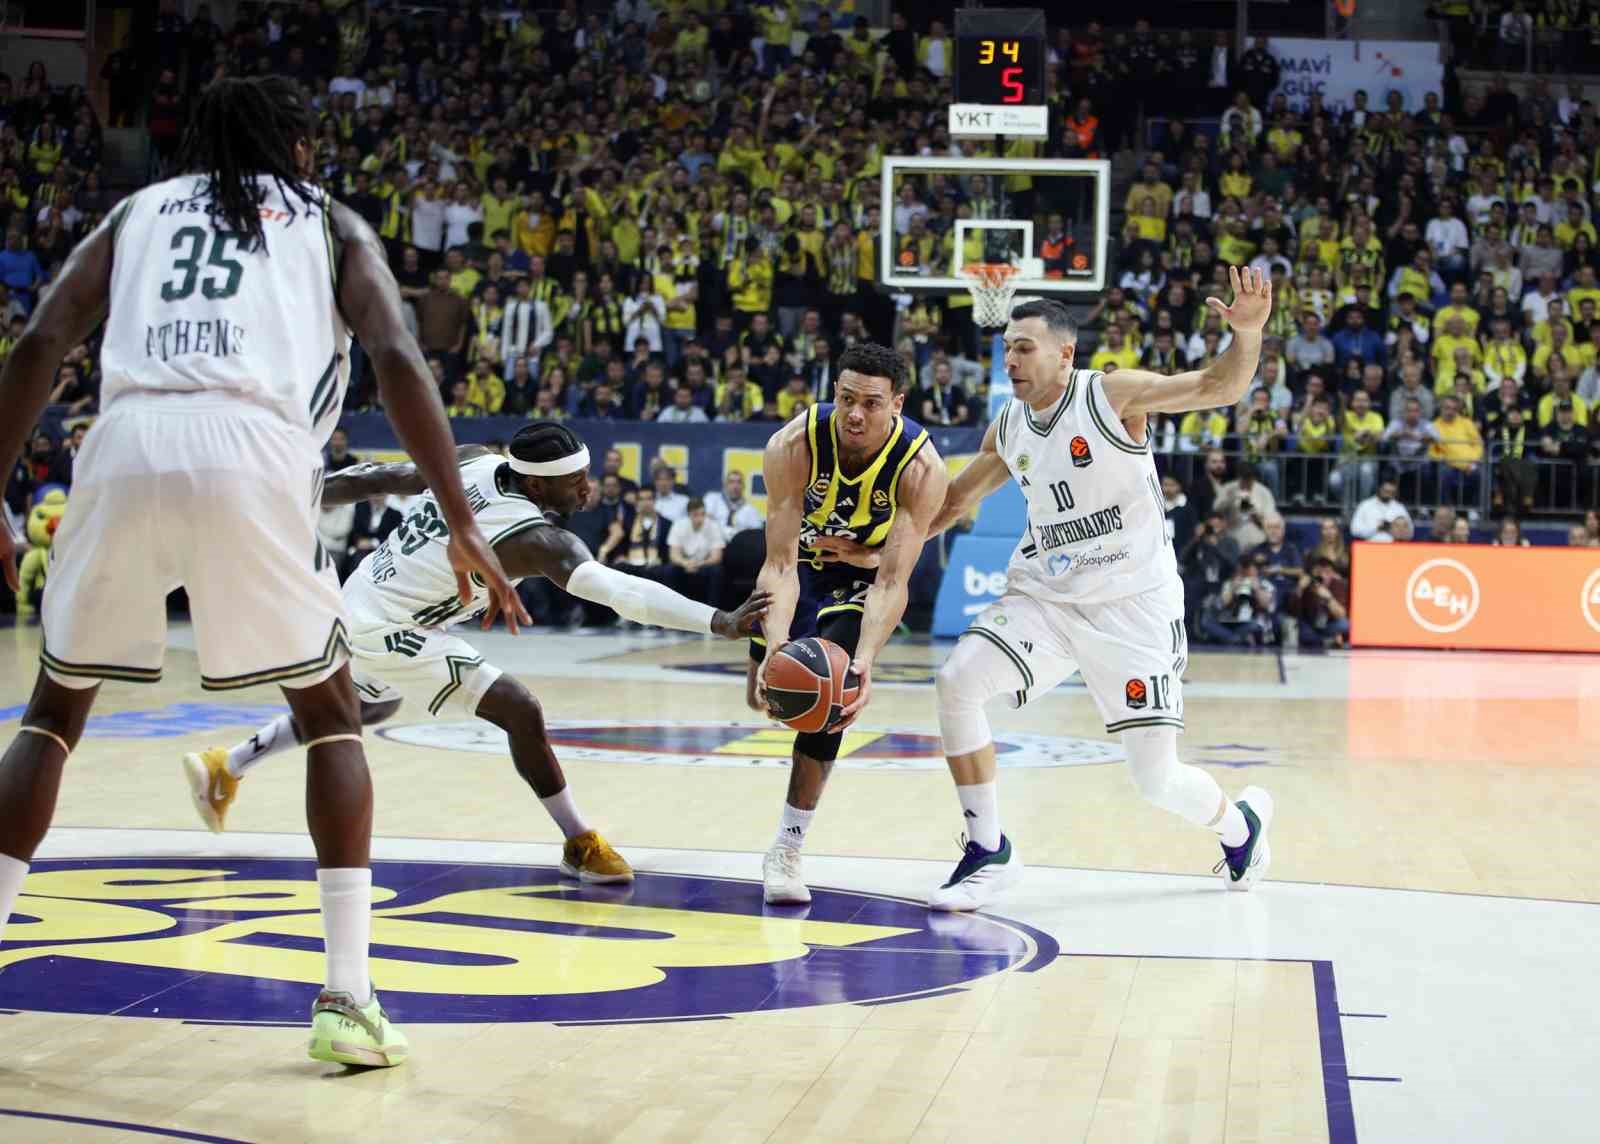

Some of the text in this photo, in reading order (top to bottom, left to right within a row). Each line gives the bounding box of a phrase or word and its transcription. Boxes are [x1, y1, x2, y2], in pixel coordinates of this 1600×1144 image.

[1001, 67, 1025, 103] 5
[956, 112, 994, 127] YKT
[161, 226, 250, 303] 35
[1049, 480, 1076, 513] 10
